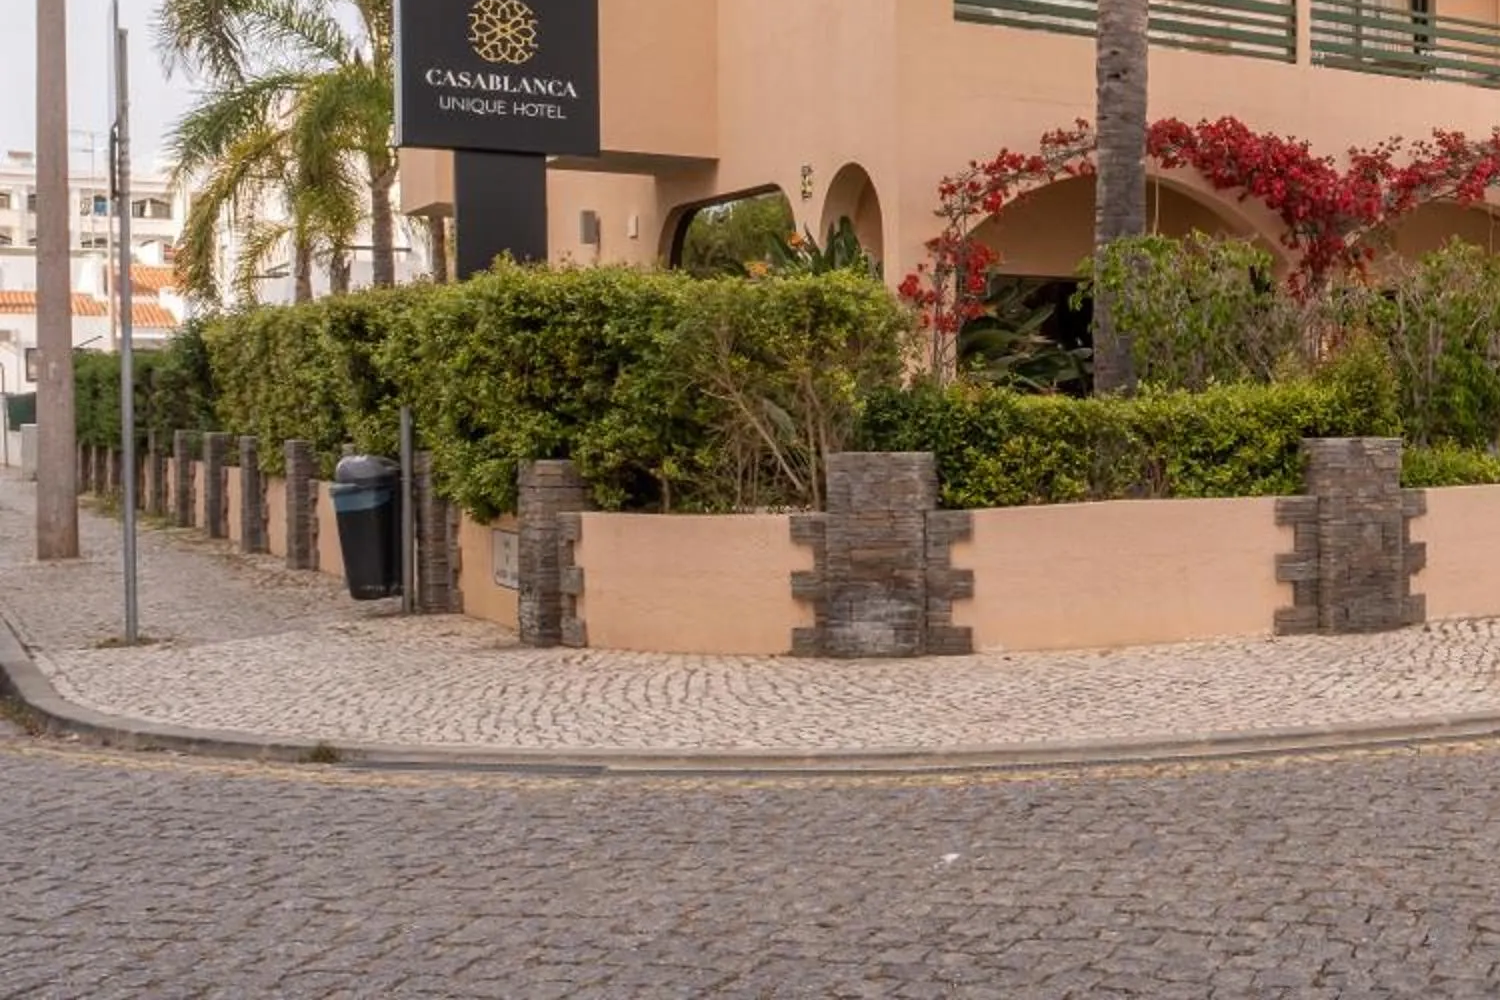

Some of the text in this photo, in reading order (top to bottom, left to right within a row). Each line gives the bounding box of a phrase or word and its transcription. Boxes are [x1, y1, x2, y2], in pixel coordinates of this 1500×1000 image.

[425, 68, 577, 98] CASABLANCA
[439, 95, 567, 119] UNIQUE HOTEL
